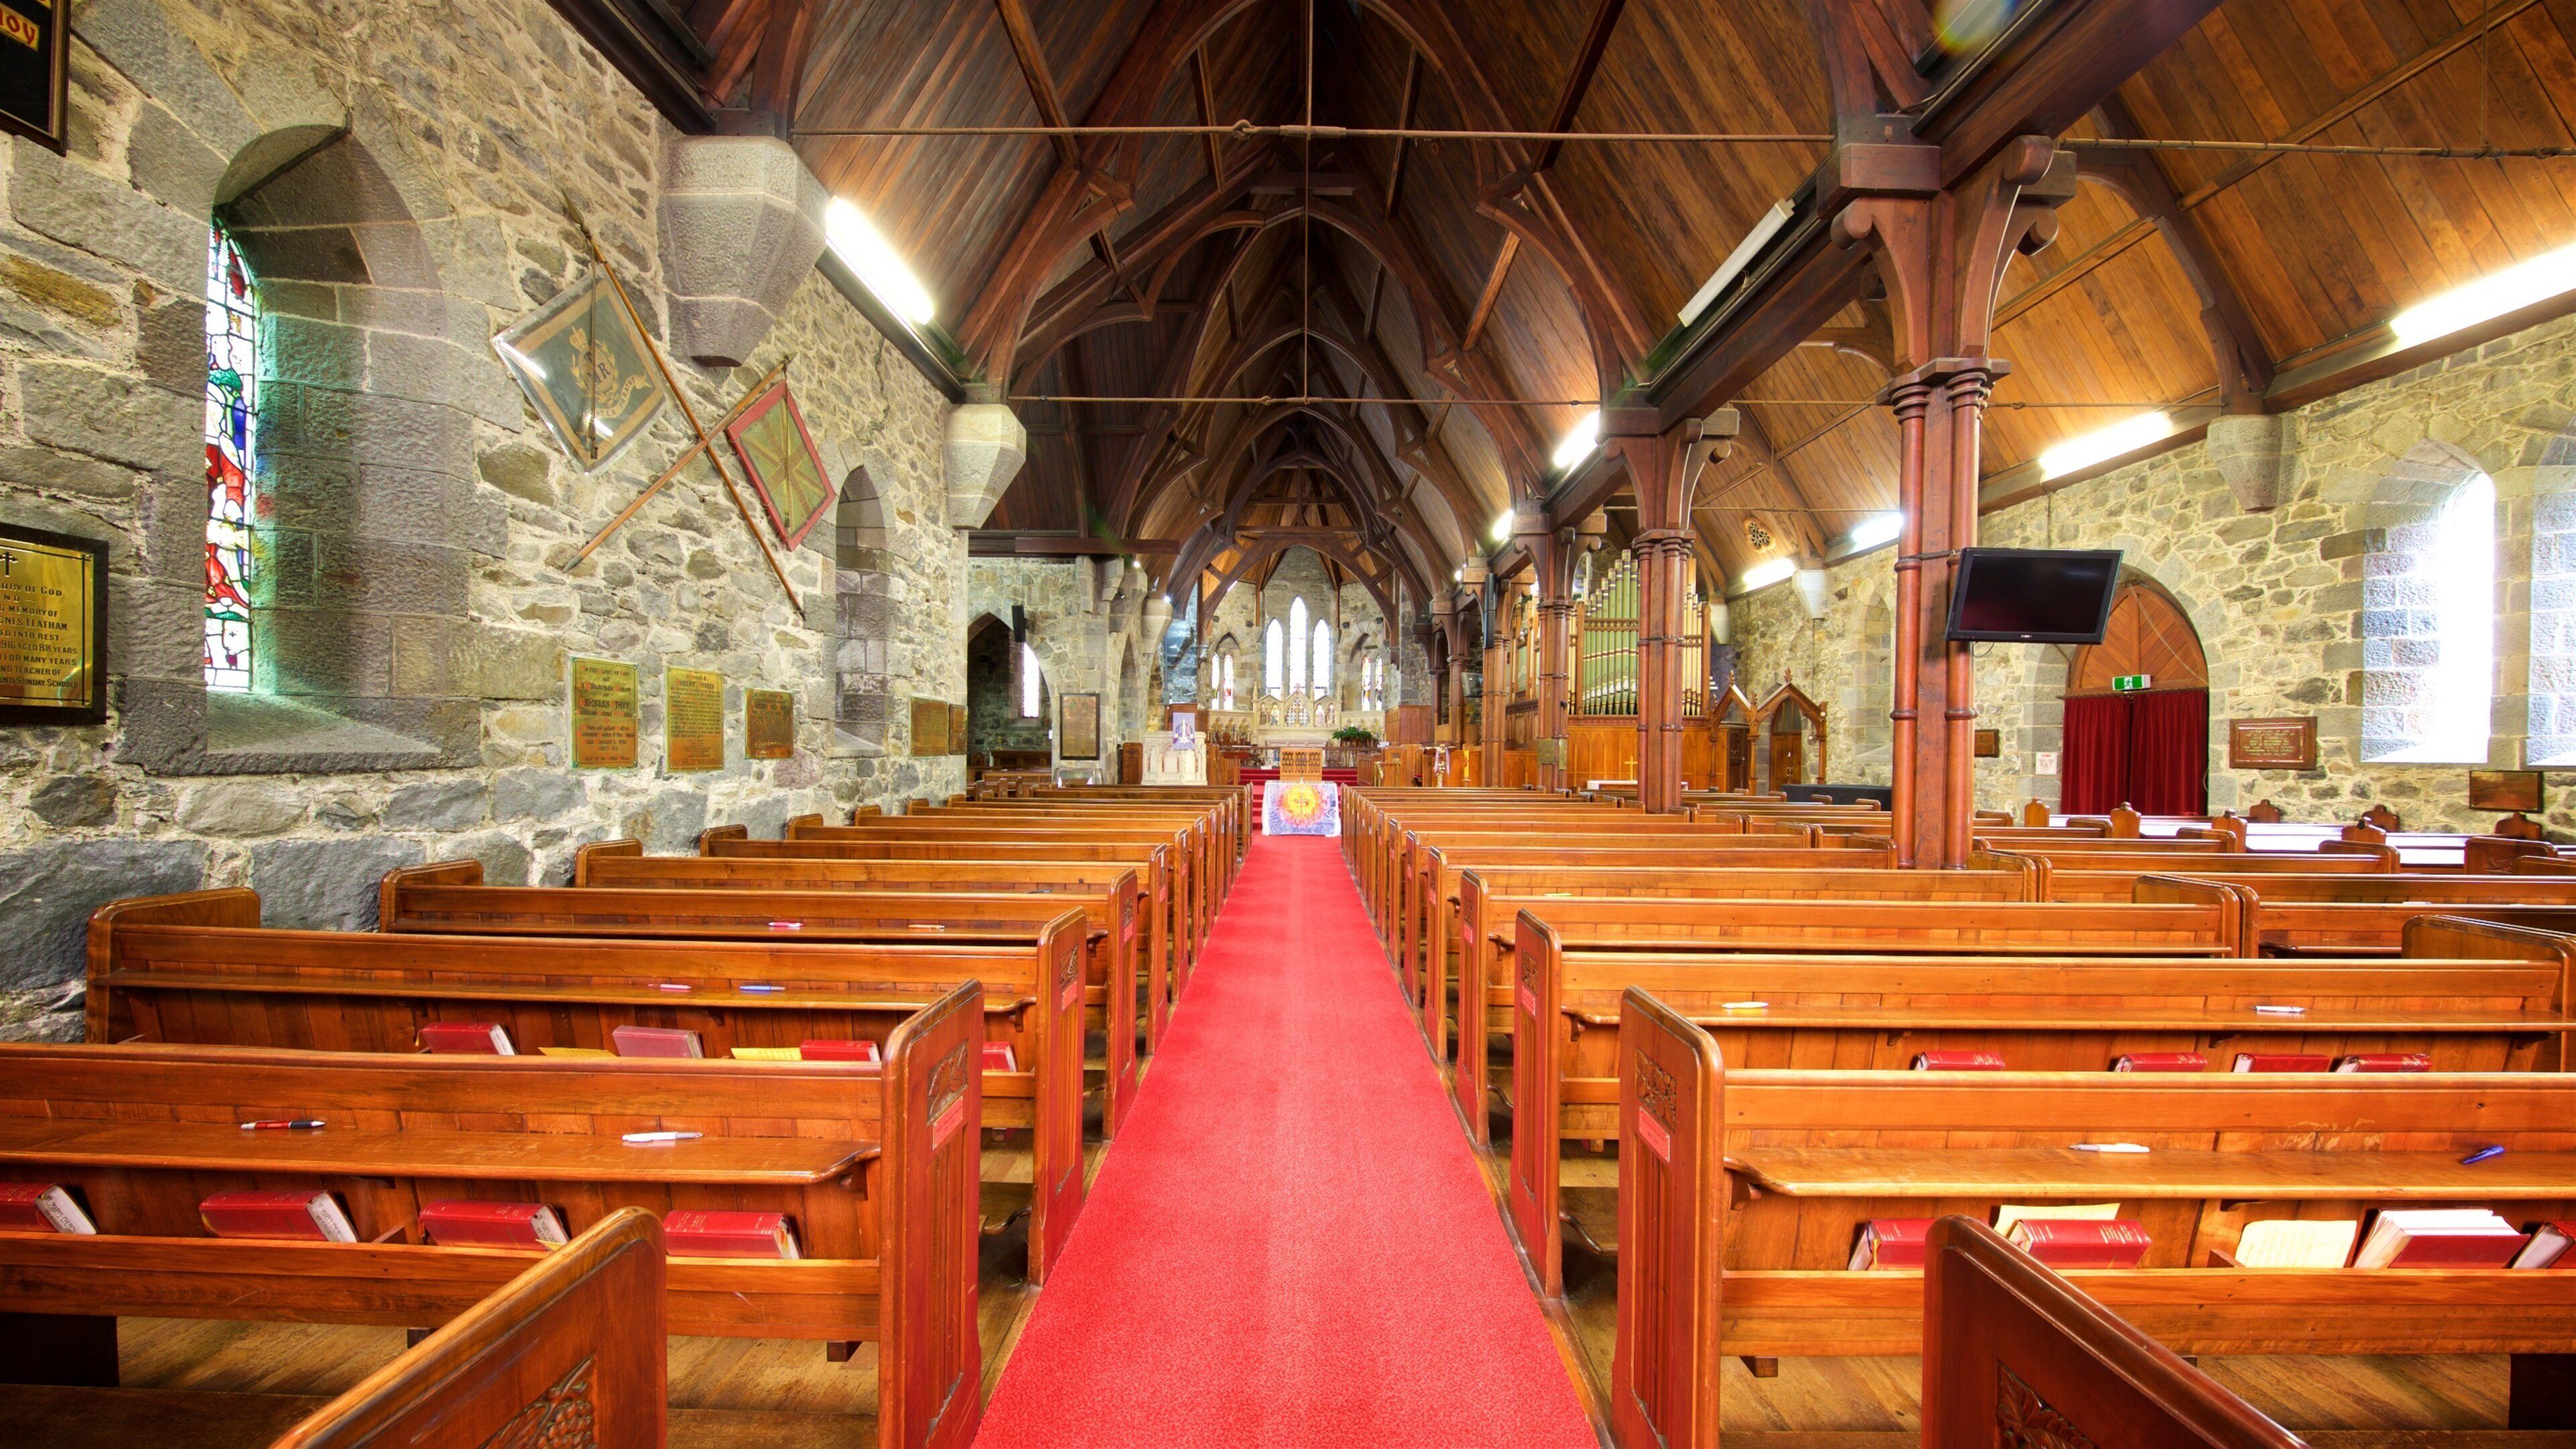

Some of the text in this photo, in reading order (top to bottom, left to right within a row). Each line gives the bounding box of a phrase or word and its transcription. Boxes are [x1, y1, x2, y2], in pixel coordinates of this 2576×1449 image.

[9, 606, 46, 615] MEMORY
[38, 633, 60, 641] REST
[17, 643, 38, 651] AGED
[39, 643, 52, 652] 88
[53, 646, 78, 654] YEARS
[5, 653, 21, 661] FOR
[23, 655, 47, 663] MANY
[49, 657, 76, 665] YEARS
[15, 665, 50, 675] TEACHER
